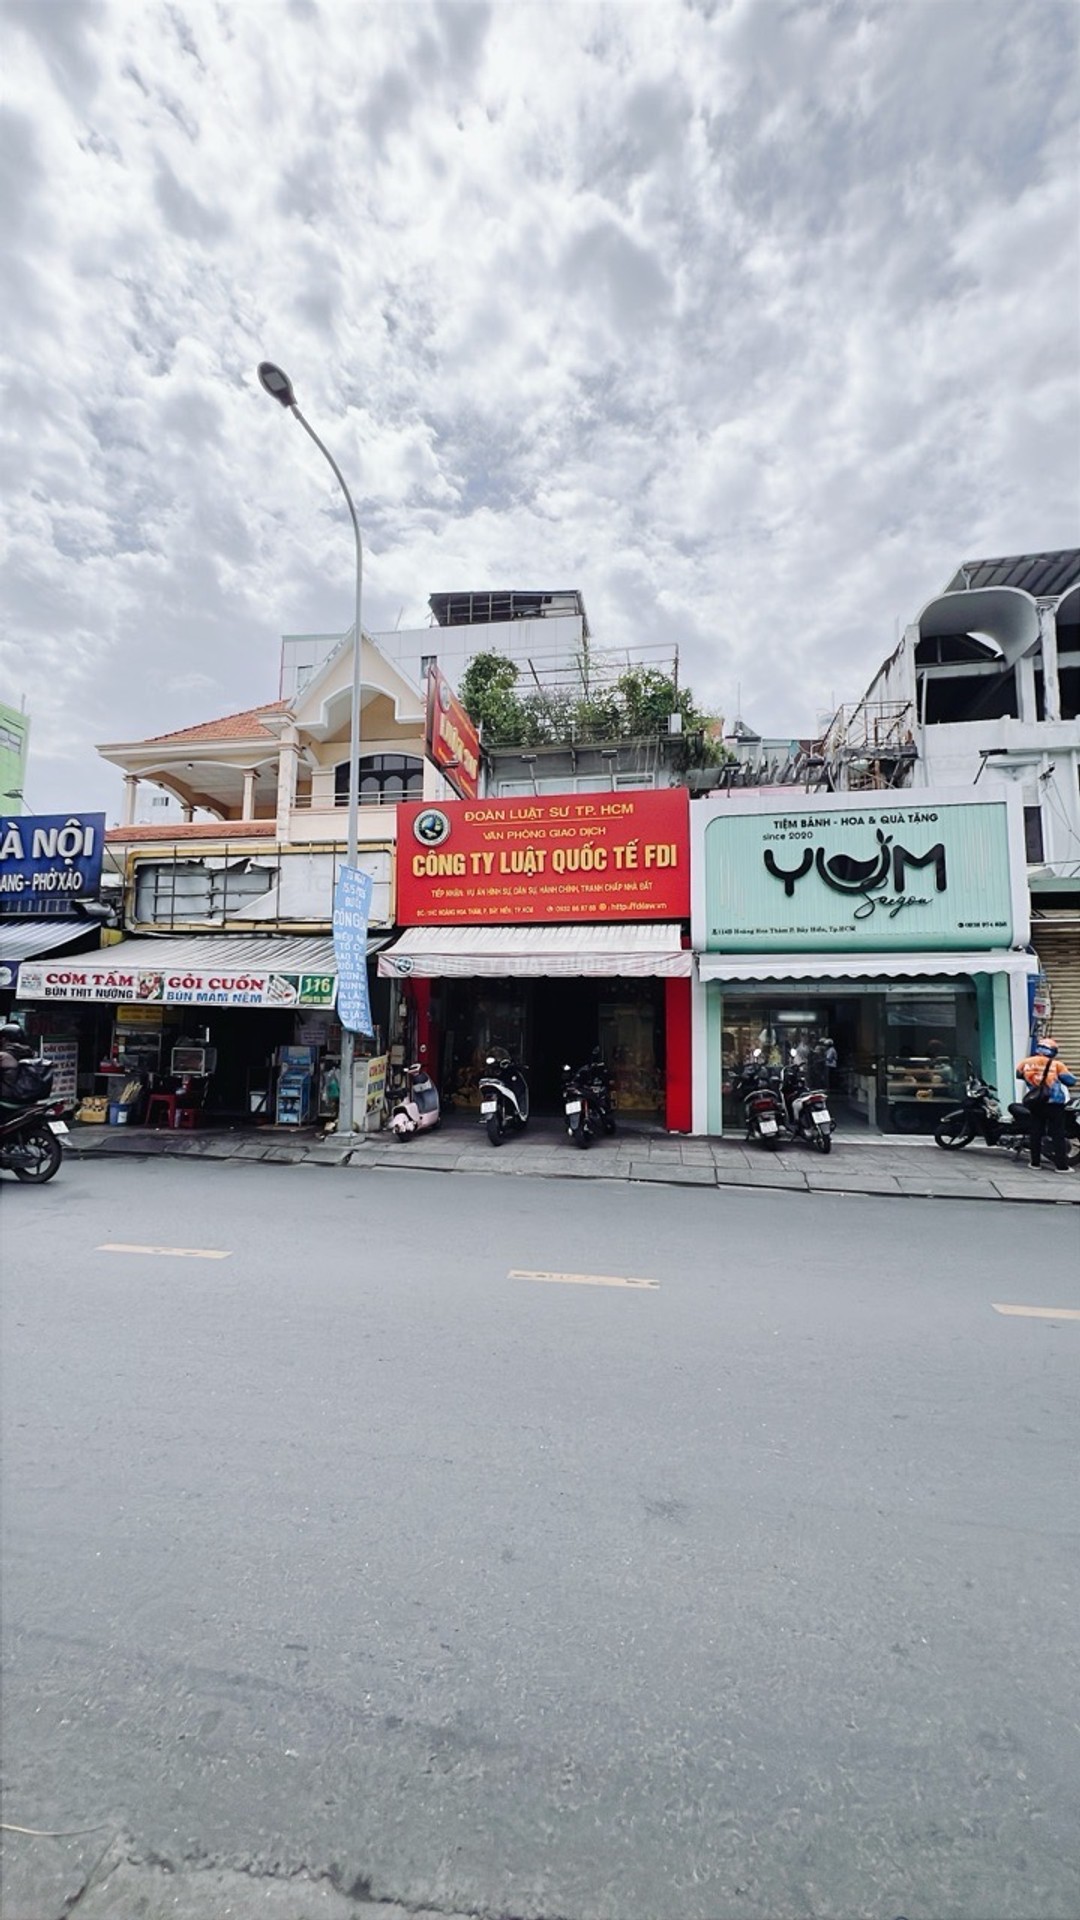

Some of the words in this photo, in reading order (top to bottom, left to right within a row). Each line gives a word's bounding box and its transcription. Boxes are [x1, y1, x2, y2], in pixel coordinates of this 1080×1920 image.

[464, 808, 505, 821] ĐOÀN
[509, 807, 545, 820] LUẬT
[549, 805, 570, 817] SƯ
[575, 805, 597, 816] TP.
[601, 803, 634, 815] HCM
[773, 819, 798, 830] TIỆM
[800, 816, 831, 828] BÁNH
[841, 817, 865, 826] HOA
[868, 816, 876, 825] &
[880, 813, 905, 824] QUÀ
[908, 813, 939, 825] TẶNG
[0, 822, 25, 859] À
[32, 818, 95, 865] NỘI
[482, 830, 504, 840] VĂN
[506, 828, 546, 839] PHÒNG
[549, 828, 577, 838] GIAO
[579, 826, 606, 837] DỊCH
[762, 832, 786, 841] since
[788, 831, 813, 840] 2020
[412, 849, 466, 877] CÔNG
[470, 851, 495, 875] TY
[500, 846, 547, 877] LUẬT
[552, 840, 607, 873] QUỐC
[612, 837, 639, 869] TẾ
[645, 844, 677, 868] FDI
[46, 972, 87, 986] CƠM
[92, 970, 134, 987] TẤM
[168, 973, 203, 990] GỎI
[208, 974, 266, 991] CUỐN
[304, 978, 330, 993] 116
[44, 986, 67, 997] BÚN
[70, 988, 92, 998] THỊT
[95, 988, 133, 999] NƯỚNG
[166, 991, 193, 1001] BÚN
